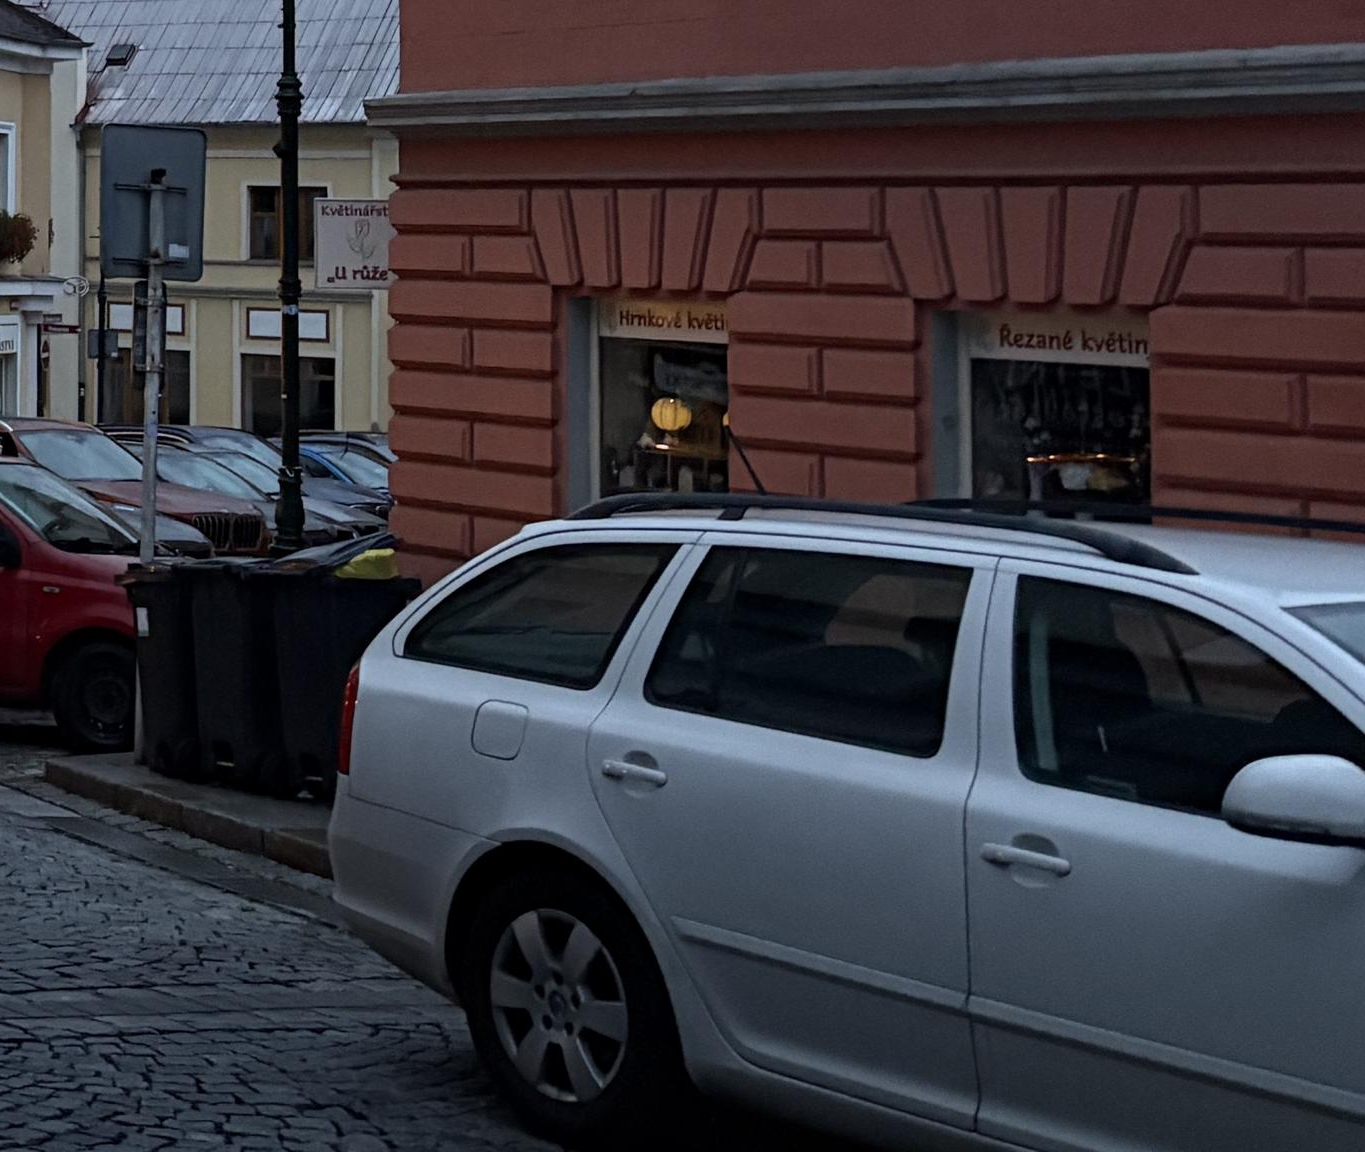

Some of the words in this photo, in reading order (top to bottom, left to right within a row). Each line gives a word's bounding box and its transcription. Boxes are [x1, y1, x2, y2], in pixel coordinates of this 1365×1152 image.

[619, 308, 682, 328] Hrnkové
[999, 323, 1073, 350] Řezané
[1081, 330, 1149, 358] květin
